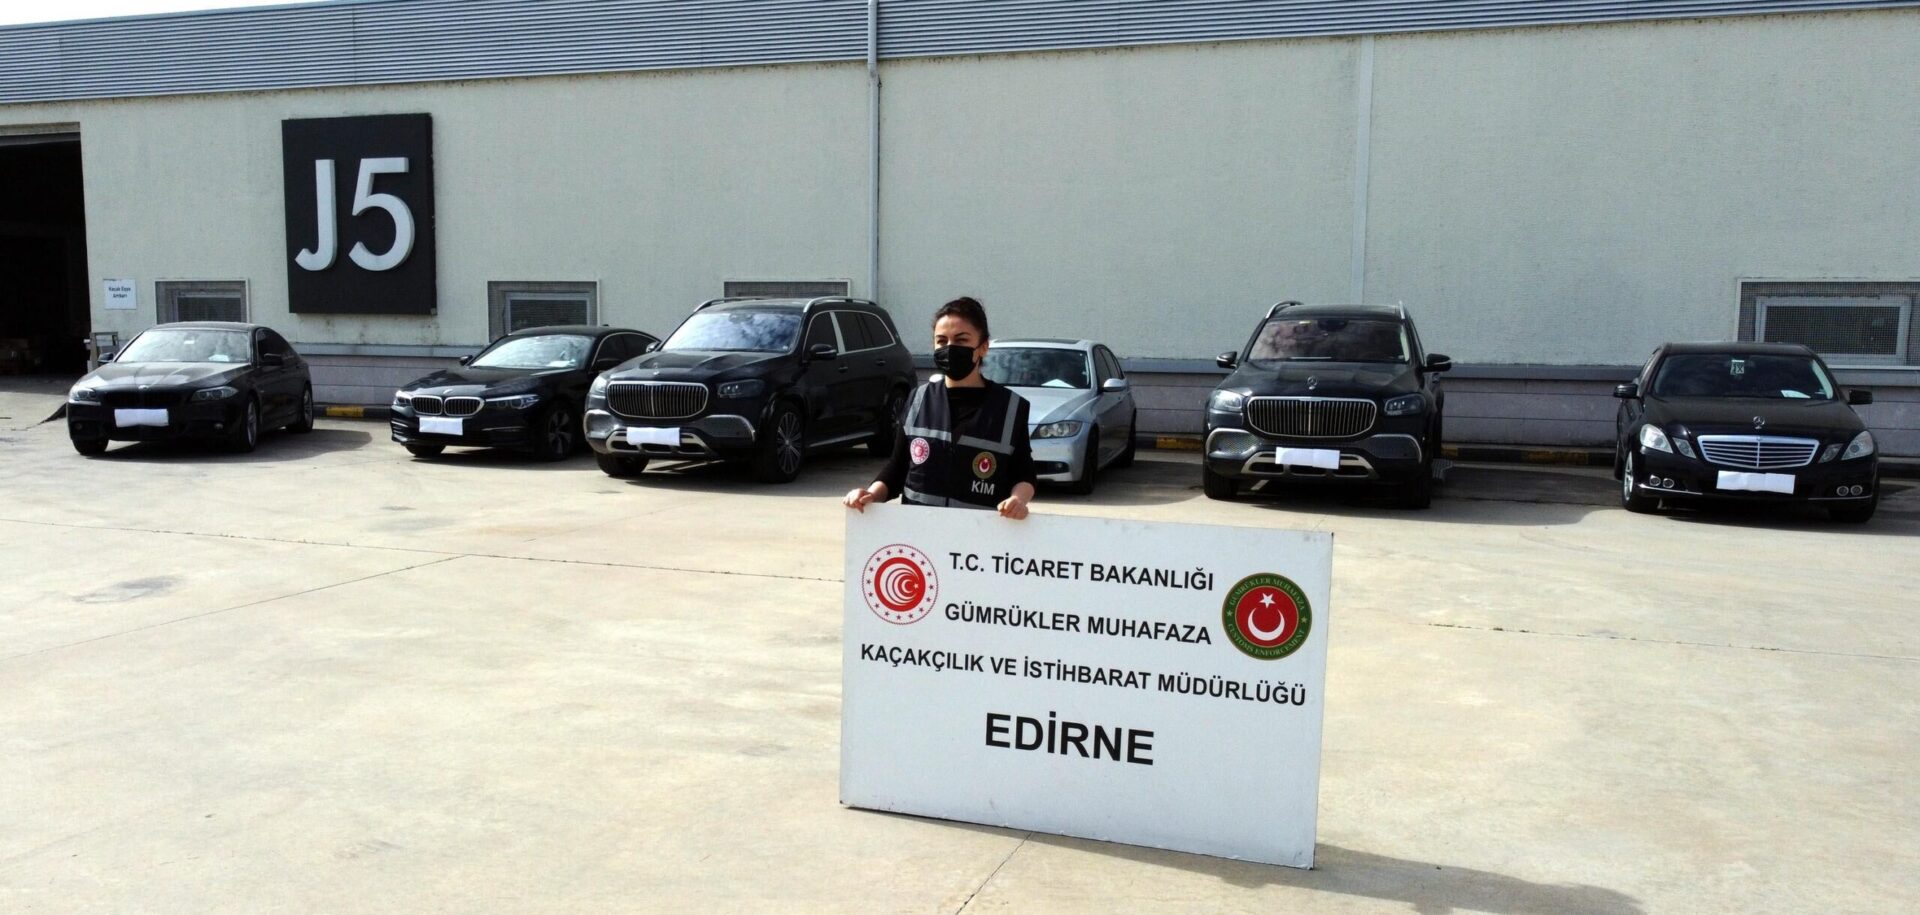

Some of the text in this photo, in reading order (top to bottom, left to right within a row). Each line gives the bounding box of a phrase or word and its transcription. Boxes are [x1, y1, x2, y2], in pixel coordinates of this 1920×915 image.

[295, 157, 415, 271] J5
[971, 479, 995, 496] KİM
[948, 552, 1214, 591] T.C. TİCARET BAKANLIĞI
[944, 600, 1212, 645] GÜMRÜKLER MUHAFAZA
[861, 643, 1306, 707] KAÇAKÇILIK VE İSTİHBARAT MÜDÜRLÜĞÜ
[985, 710, 1155, 766] EDİRNE
